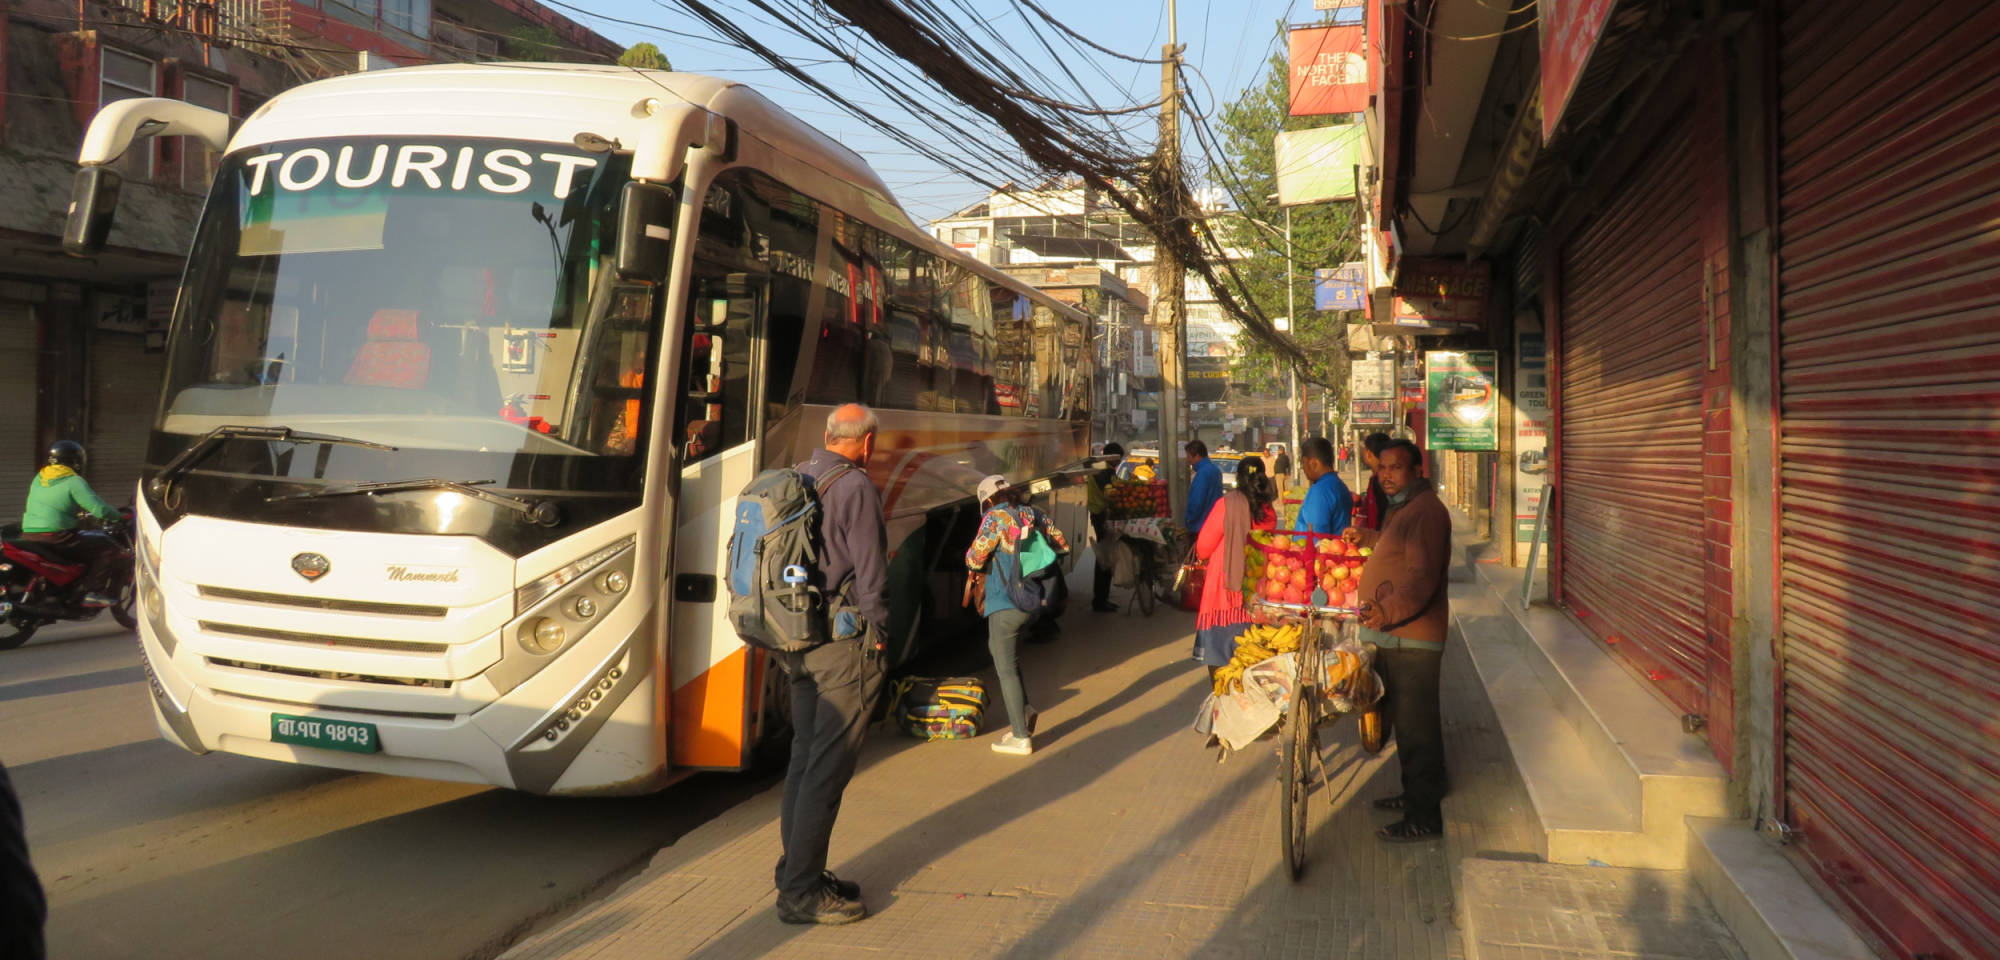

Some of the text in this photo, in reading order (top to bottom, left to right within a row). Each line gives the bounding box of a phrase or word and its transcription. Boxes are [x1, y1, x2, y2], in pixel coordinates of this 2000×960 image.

[1318, 52, 1344, 64] THE
[1297, 62, 1346, 76] NORTH
[1312, 74, 1346, 86] FACE
[246, 144, 598, 199] TOURIST
[1529, 399, 1545, 407] TOU
[386, 566, 459, 583] Mammoth
